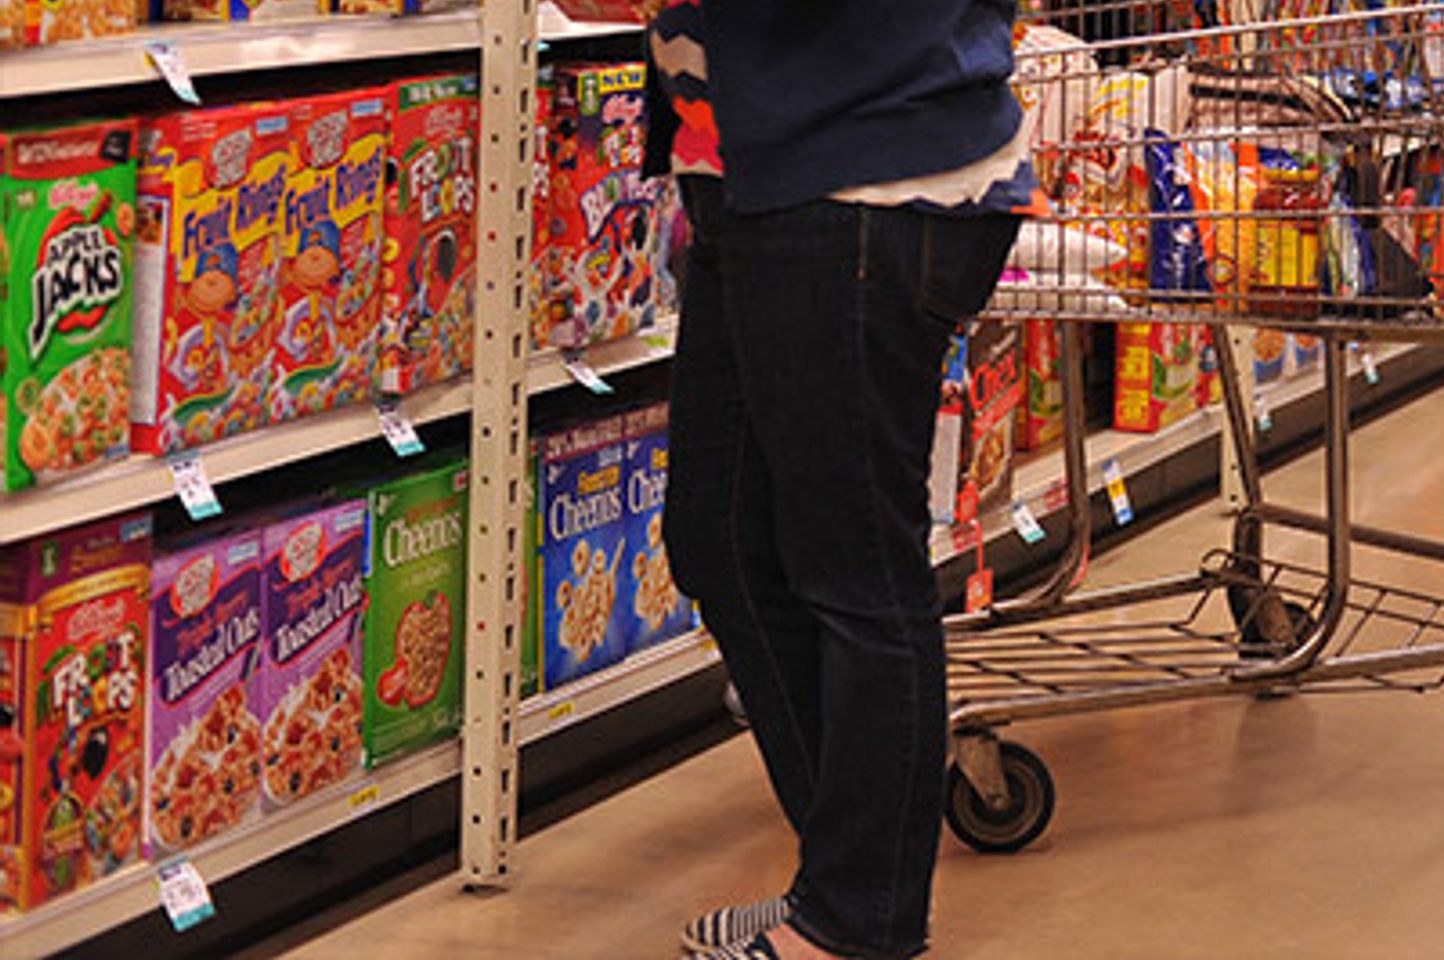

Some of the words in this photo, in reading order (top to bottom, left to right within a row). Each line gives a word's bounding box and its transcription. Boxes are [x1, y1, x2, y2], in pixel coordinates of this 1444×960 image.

[285, 173, 331, 237] Fruit
[335, 141, 384, 211] Rings
[409, 136, 472, 200] FROOT
[183, 194, 233, 260] Fruit
[235, 162, 287, 232] Rings
[421, 174, 475, 225] LOOPS
[30, 247, 121, 359] JACKS
[550, 487, 622, 541] Cheerios
[627, 468, 668, 515] Chee
[384, 512, 462, 568] Cheerios
[54, 631, 136, 708] FROOT
[68, 671, 138, 729] LOOPS
